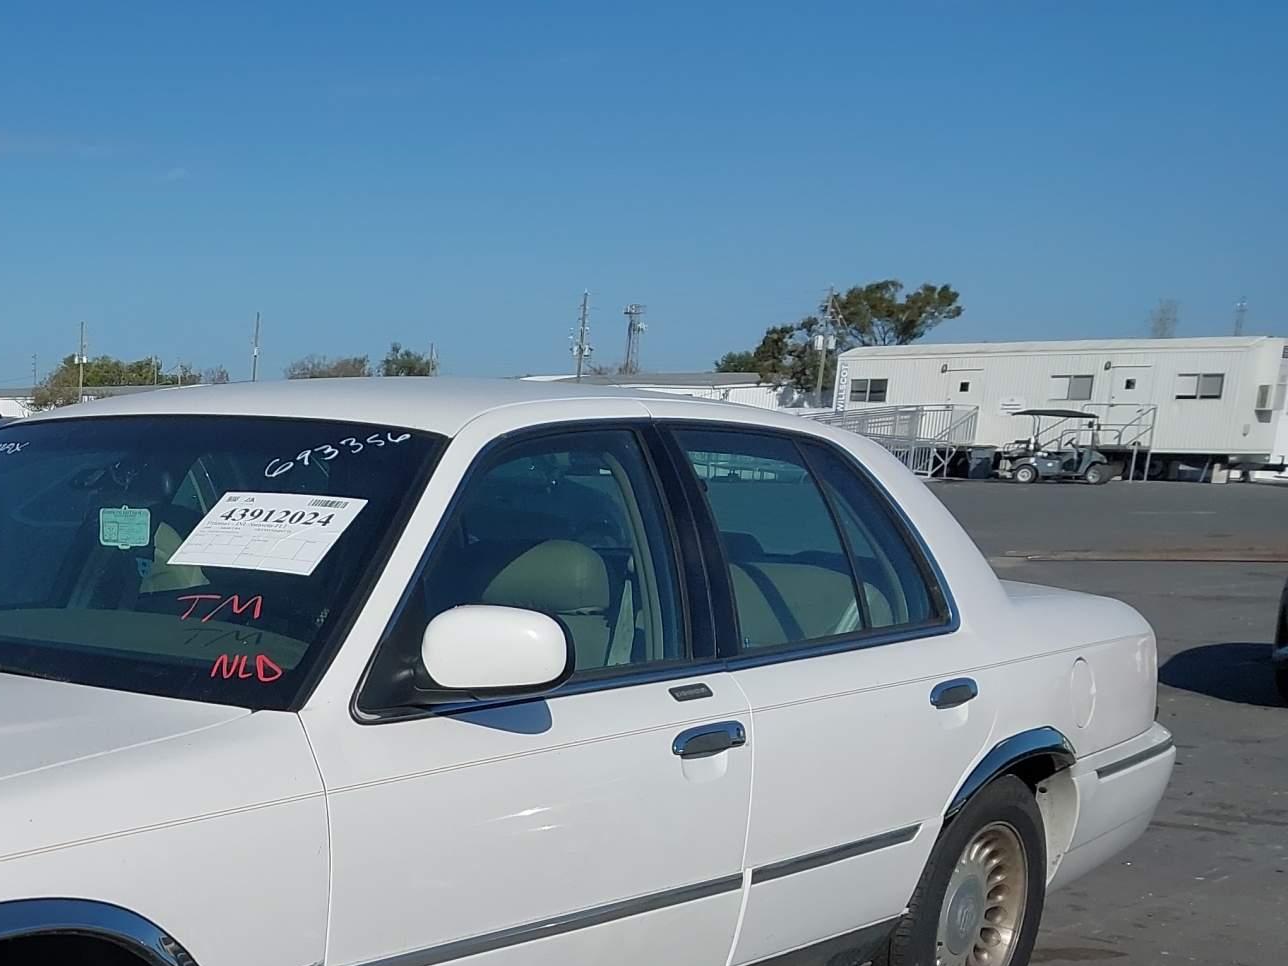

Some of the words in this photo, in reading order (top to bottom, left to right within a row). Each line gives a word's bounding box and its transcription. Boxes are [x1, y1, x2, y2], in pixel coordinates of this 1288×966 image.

[264, 432, 412, 478] 693356
[219, 507, 337, 527] 43912024
[211, 654, 283, 682] NLD
